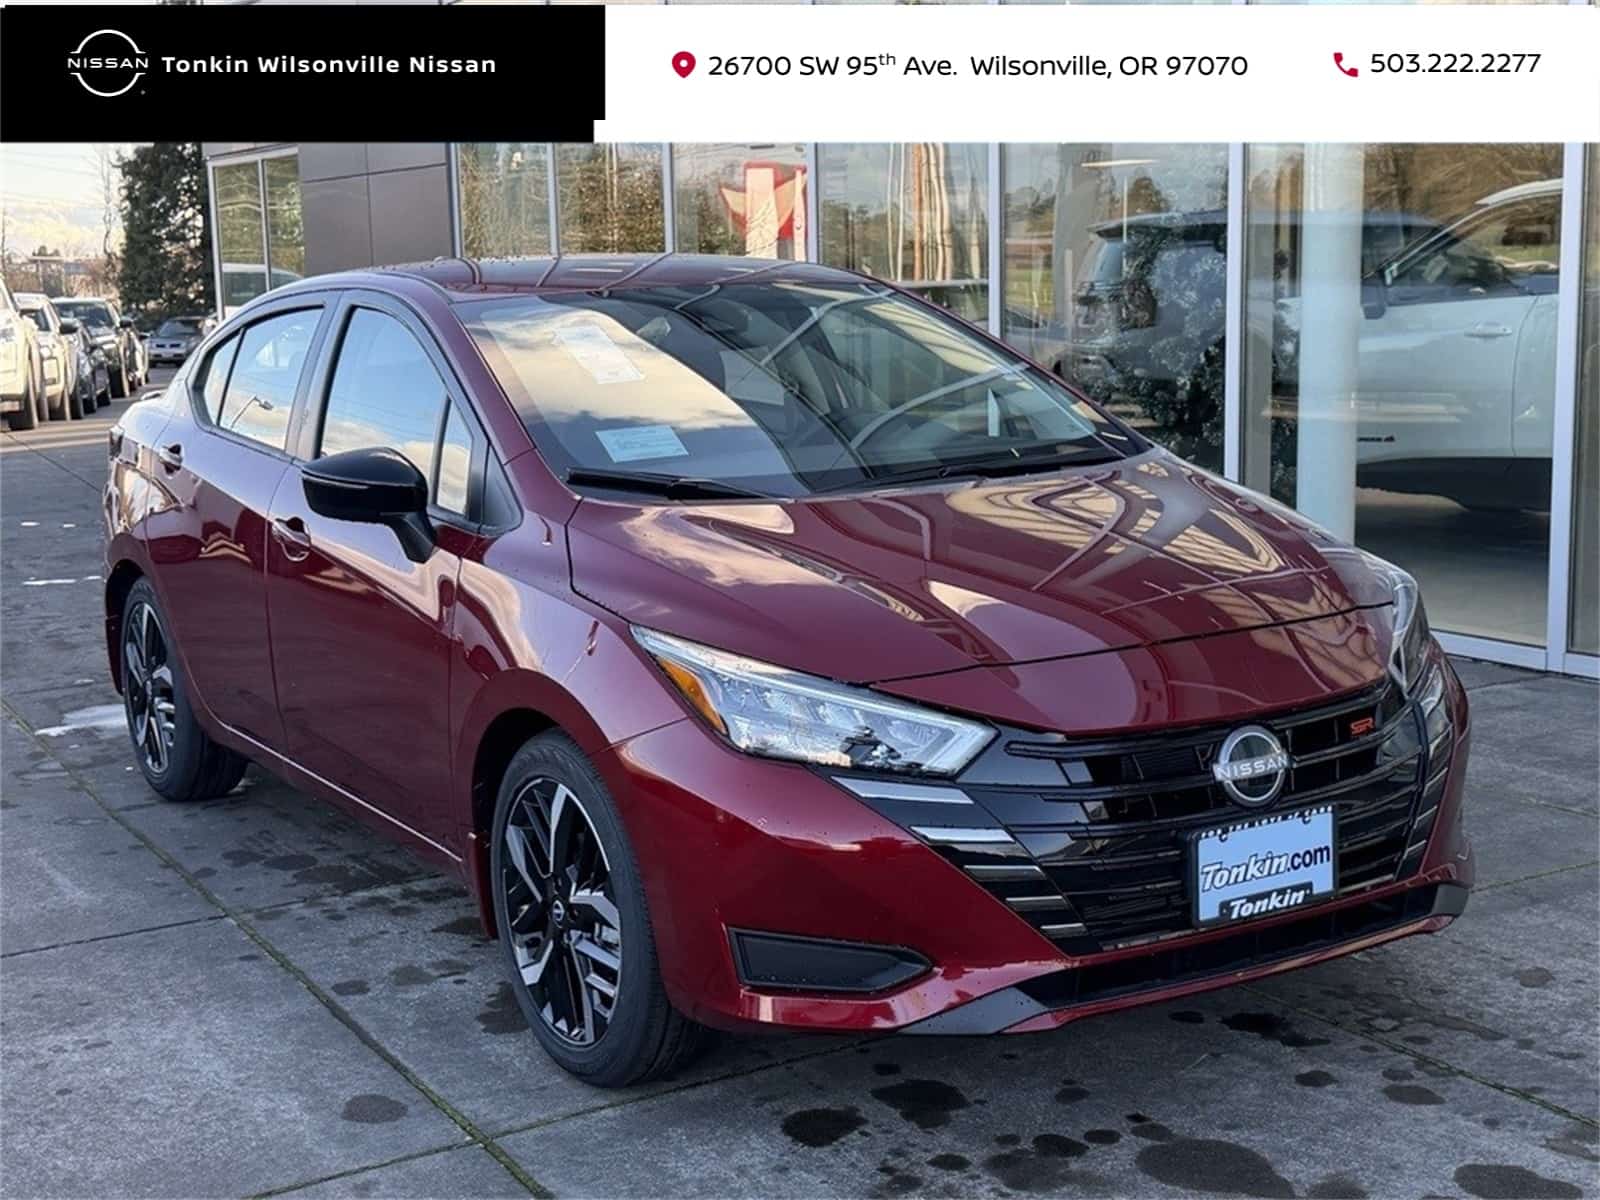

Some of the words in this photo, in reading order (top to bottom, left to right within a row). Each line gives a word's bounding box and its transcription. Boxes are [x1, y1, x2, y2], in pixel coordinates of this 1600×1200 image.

[1351, 717, 1374, 735] SR
[1216, 753, 1288, 779] NISSAN
[1200, 844, 1331, 893] Tonkin.com
[1229, 888, 1306, 920] Tonkin
